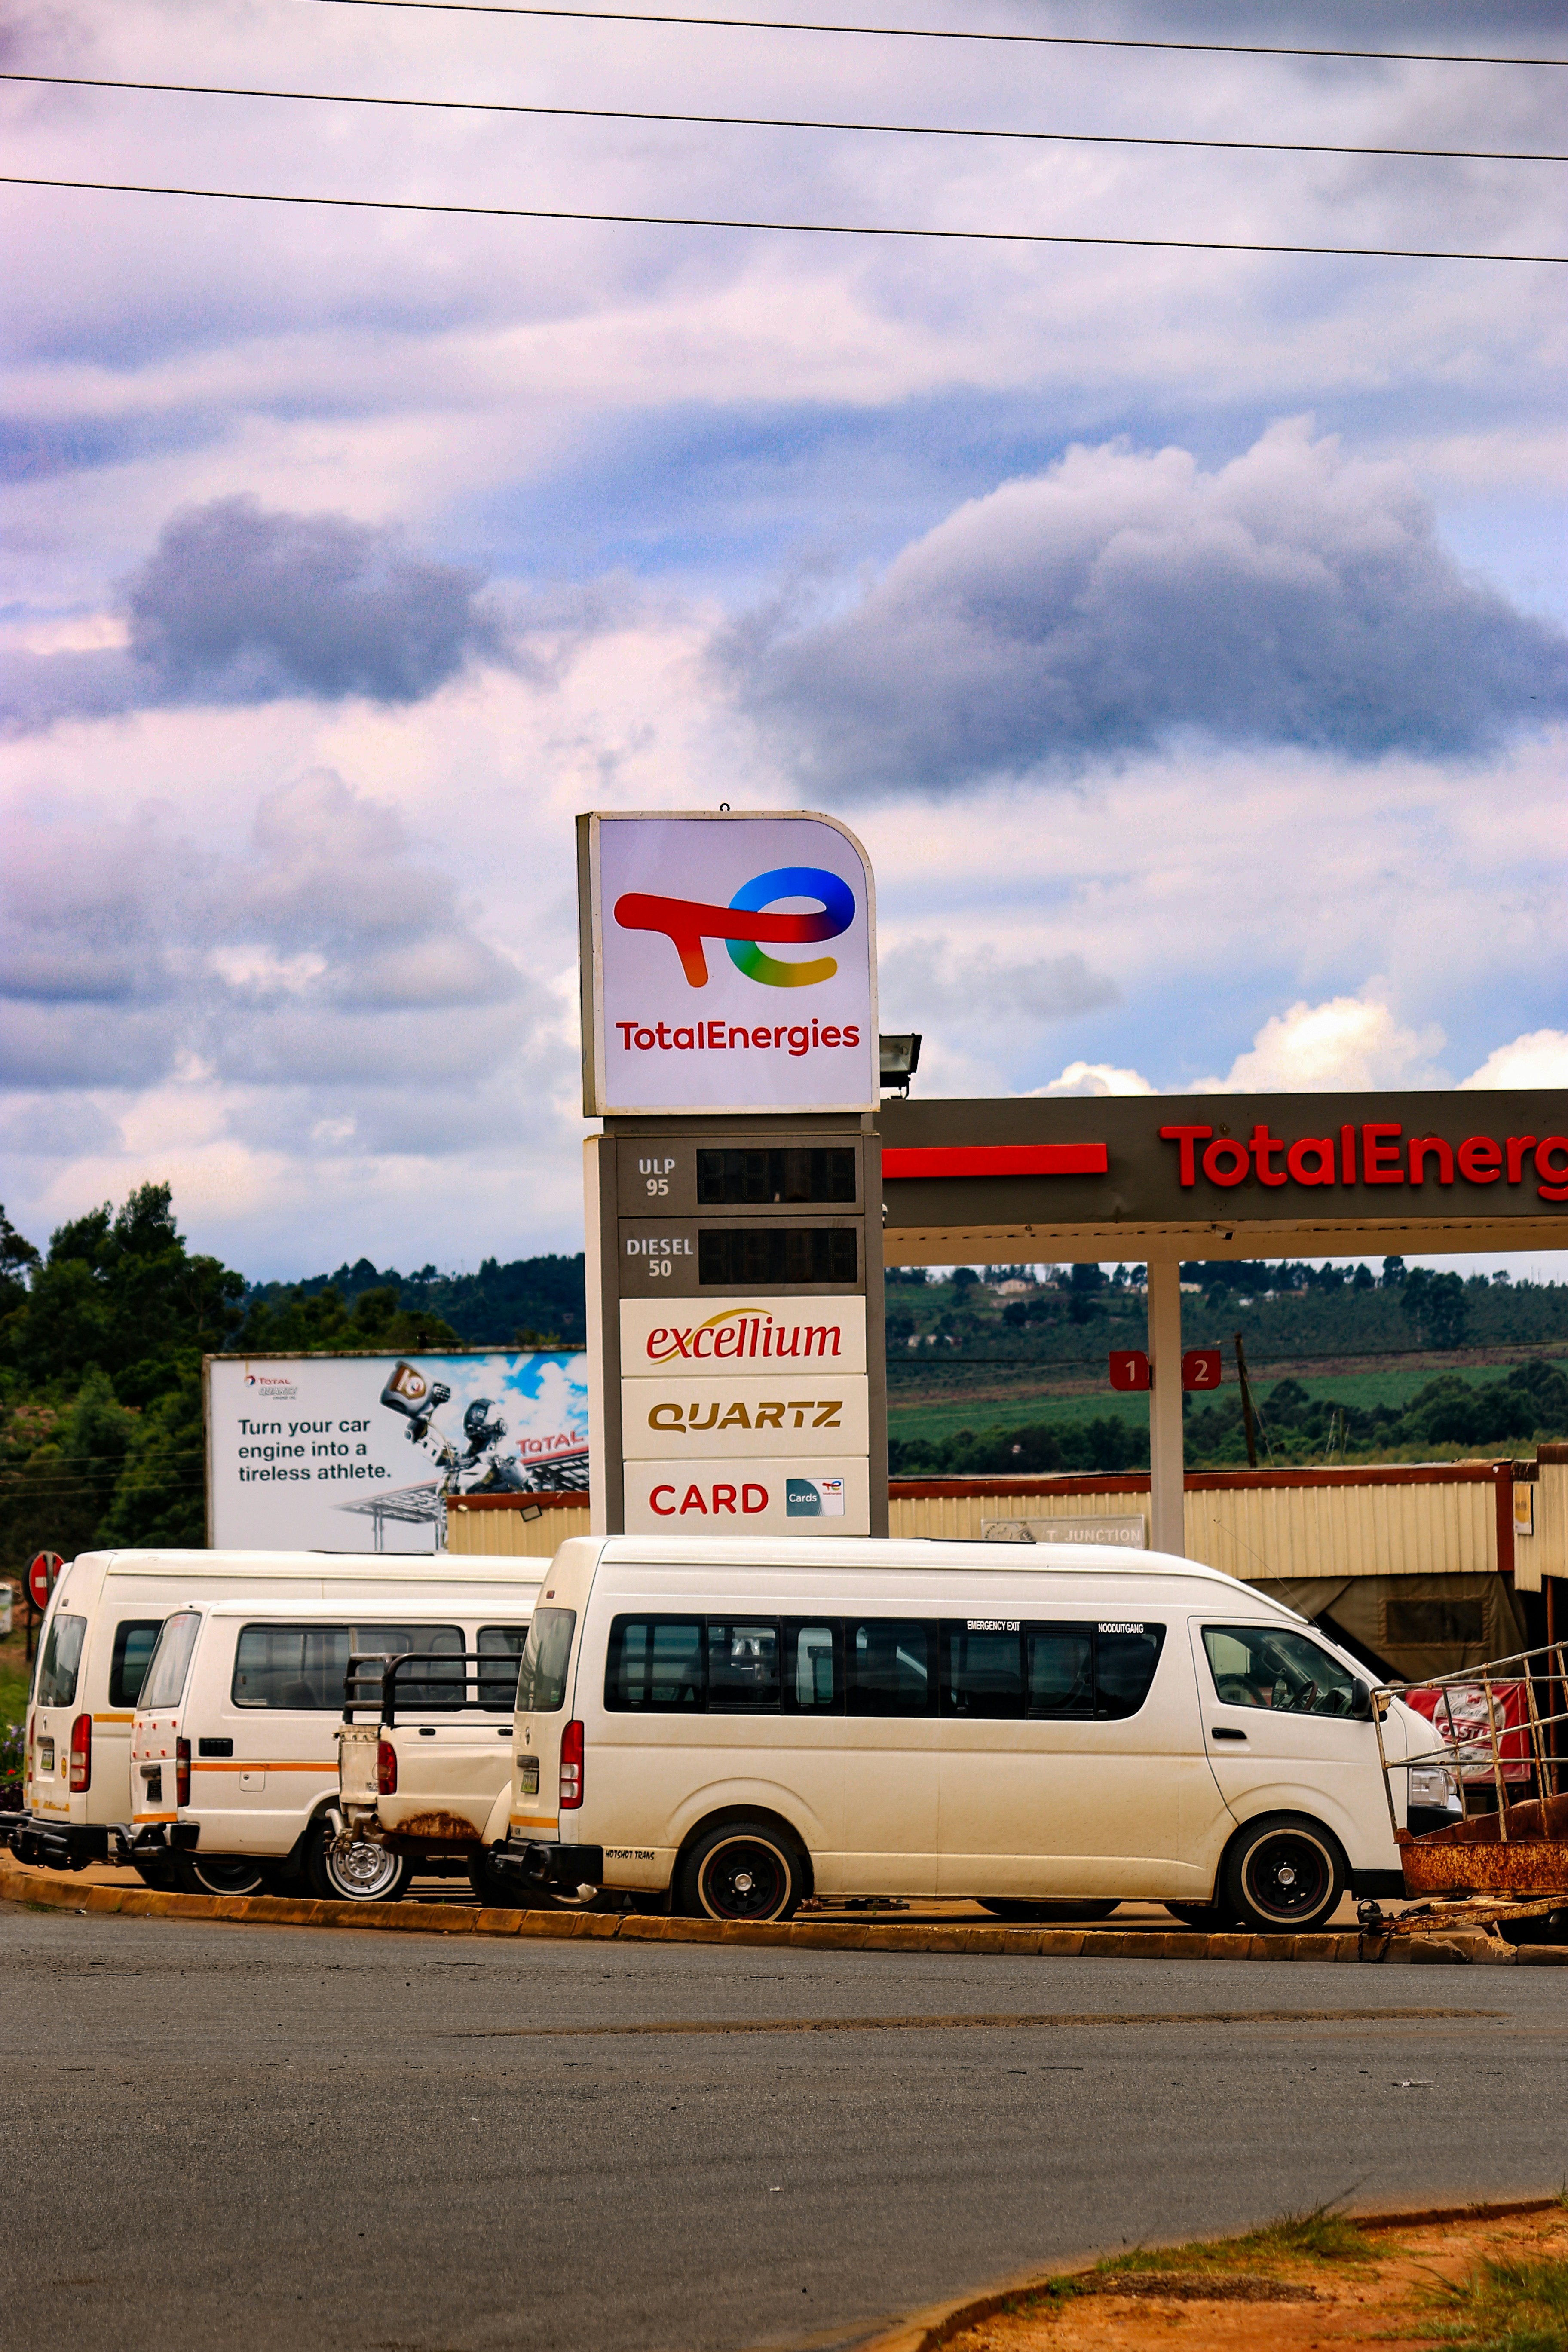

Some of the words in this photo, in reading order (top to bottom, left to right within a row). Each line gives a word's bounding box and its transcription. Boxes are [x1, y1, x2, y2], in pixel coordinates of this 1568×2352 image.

[615, 1018, 860, 1056] TotalEnergies
[639, 1159, 675, 1174] ULP
[1159, 1124, 1568, 1201] TotalEnerg
[646, 1179, 669, 1196] 95
[627, 1239, 693, 1255] DIESEL
[649, 1260, 671, 1277] 50
[646, 1316, 841, 1359] excellium
[1125, 1360, 1135, 1381] 1
[1195, 1360, 1209, 1381] 2
[648, 1400, 842, 1433] QUARTZ
[238, 1419, 281, 1435] Turn
[288, 1420, 332, 1437] your
[339, 1420, 370, 1432] car
[239, 1442, 304, 1461] engine
[312, 1441, 349, 1456] into
[355, 1443, 367, 1455] a
[516, 1430, 583, 1455] TOTAL
[238, 1466, 311, 1481] tireless
[317, 1464, 391, 1479] athlete.
[649, 1483, 769, 1516] CARD
[789, 1493, 817, 1502] Cards
[1046, 1531, 1056, 1542] T
[1065, 1529, 1140, 1542] JUNCTION
[967, 1620, 1006, 1631] EMERGENCY
[1007, 1621, 1020, 1631] EXIT
[1098, 1623, 1144, 1633] NOODUITGANG
[606, 1850, 633, 1859] HOTSHOT
[635, 1851, 655, 1860] TRANS
